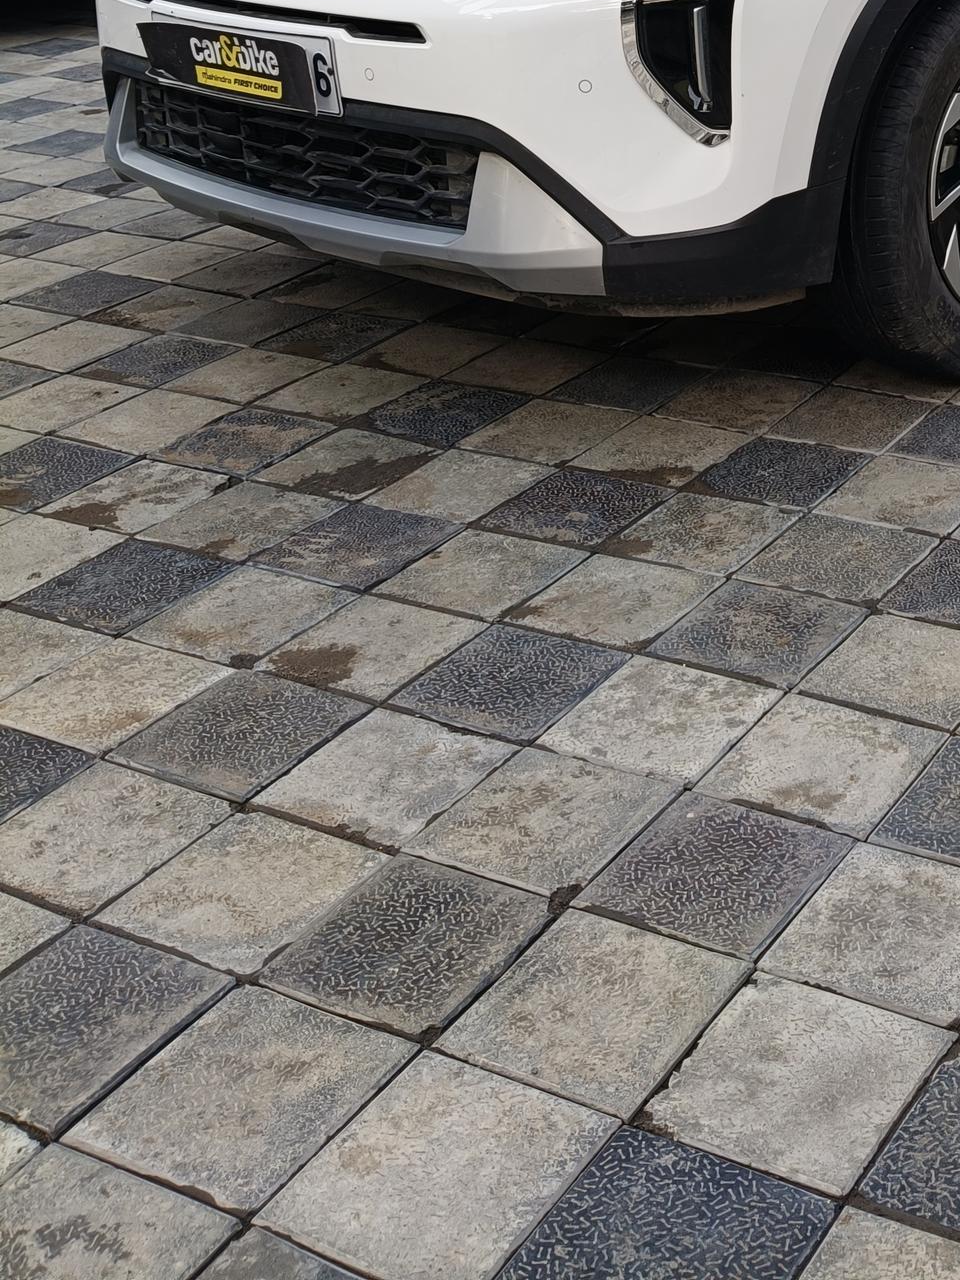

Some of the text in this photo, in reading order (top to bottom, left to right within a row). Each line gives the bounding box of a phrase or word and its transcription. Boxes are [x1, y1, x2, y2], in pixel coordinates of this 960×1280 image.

[189, 35, 280, 77] car&bike
[313, 52, 332, 98] 6
[202, 69, 279, 93] Mahindra FIRST CHOICE
